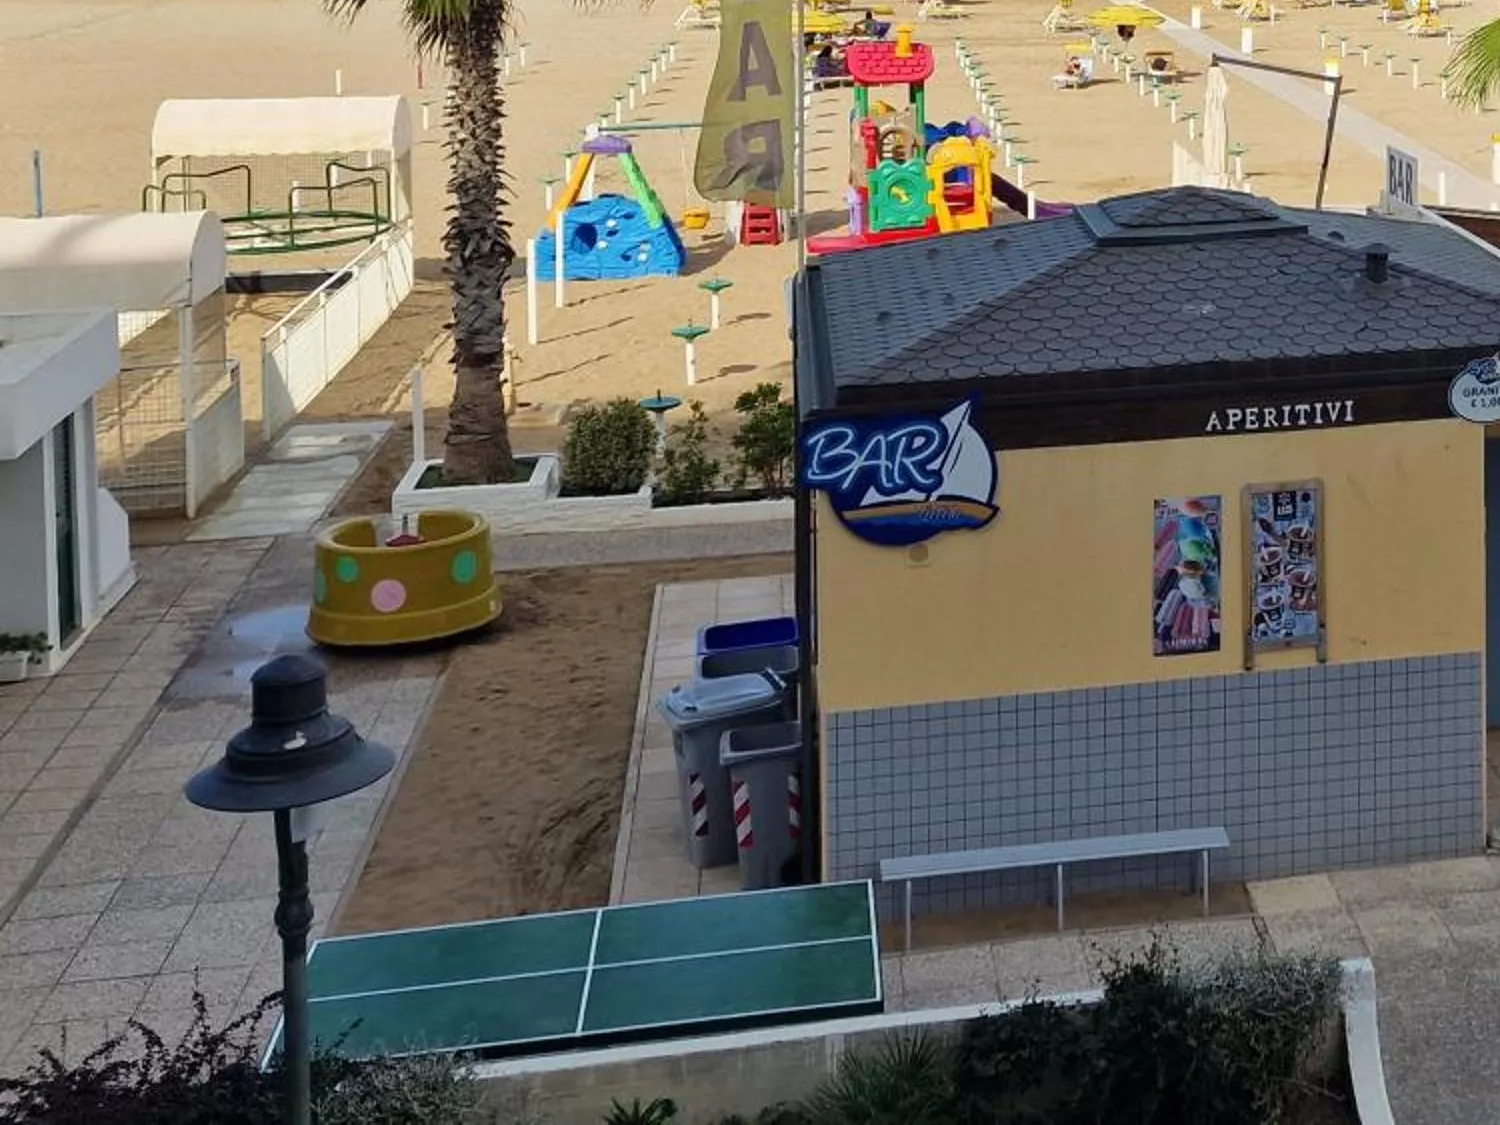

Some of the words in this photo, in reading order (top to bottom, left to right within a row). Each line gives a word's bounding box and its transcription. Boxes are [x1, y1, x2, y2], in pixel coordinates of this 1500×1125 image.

[1390, 154, 1413, 205] BAR
[1205, 400, 1354, 431] APERITIVI
[807, 425, 936, 490] BAR
